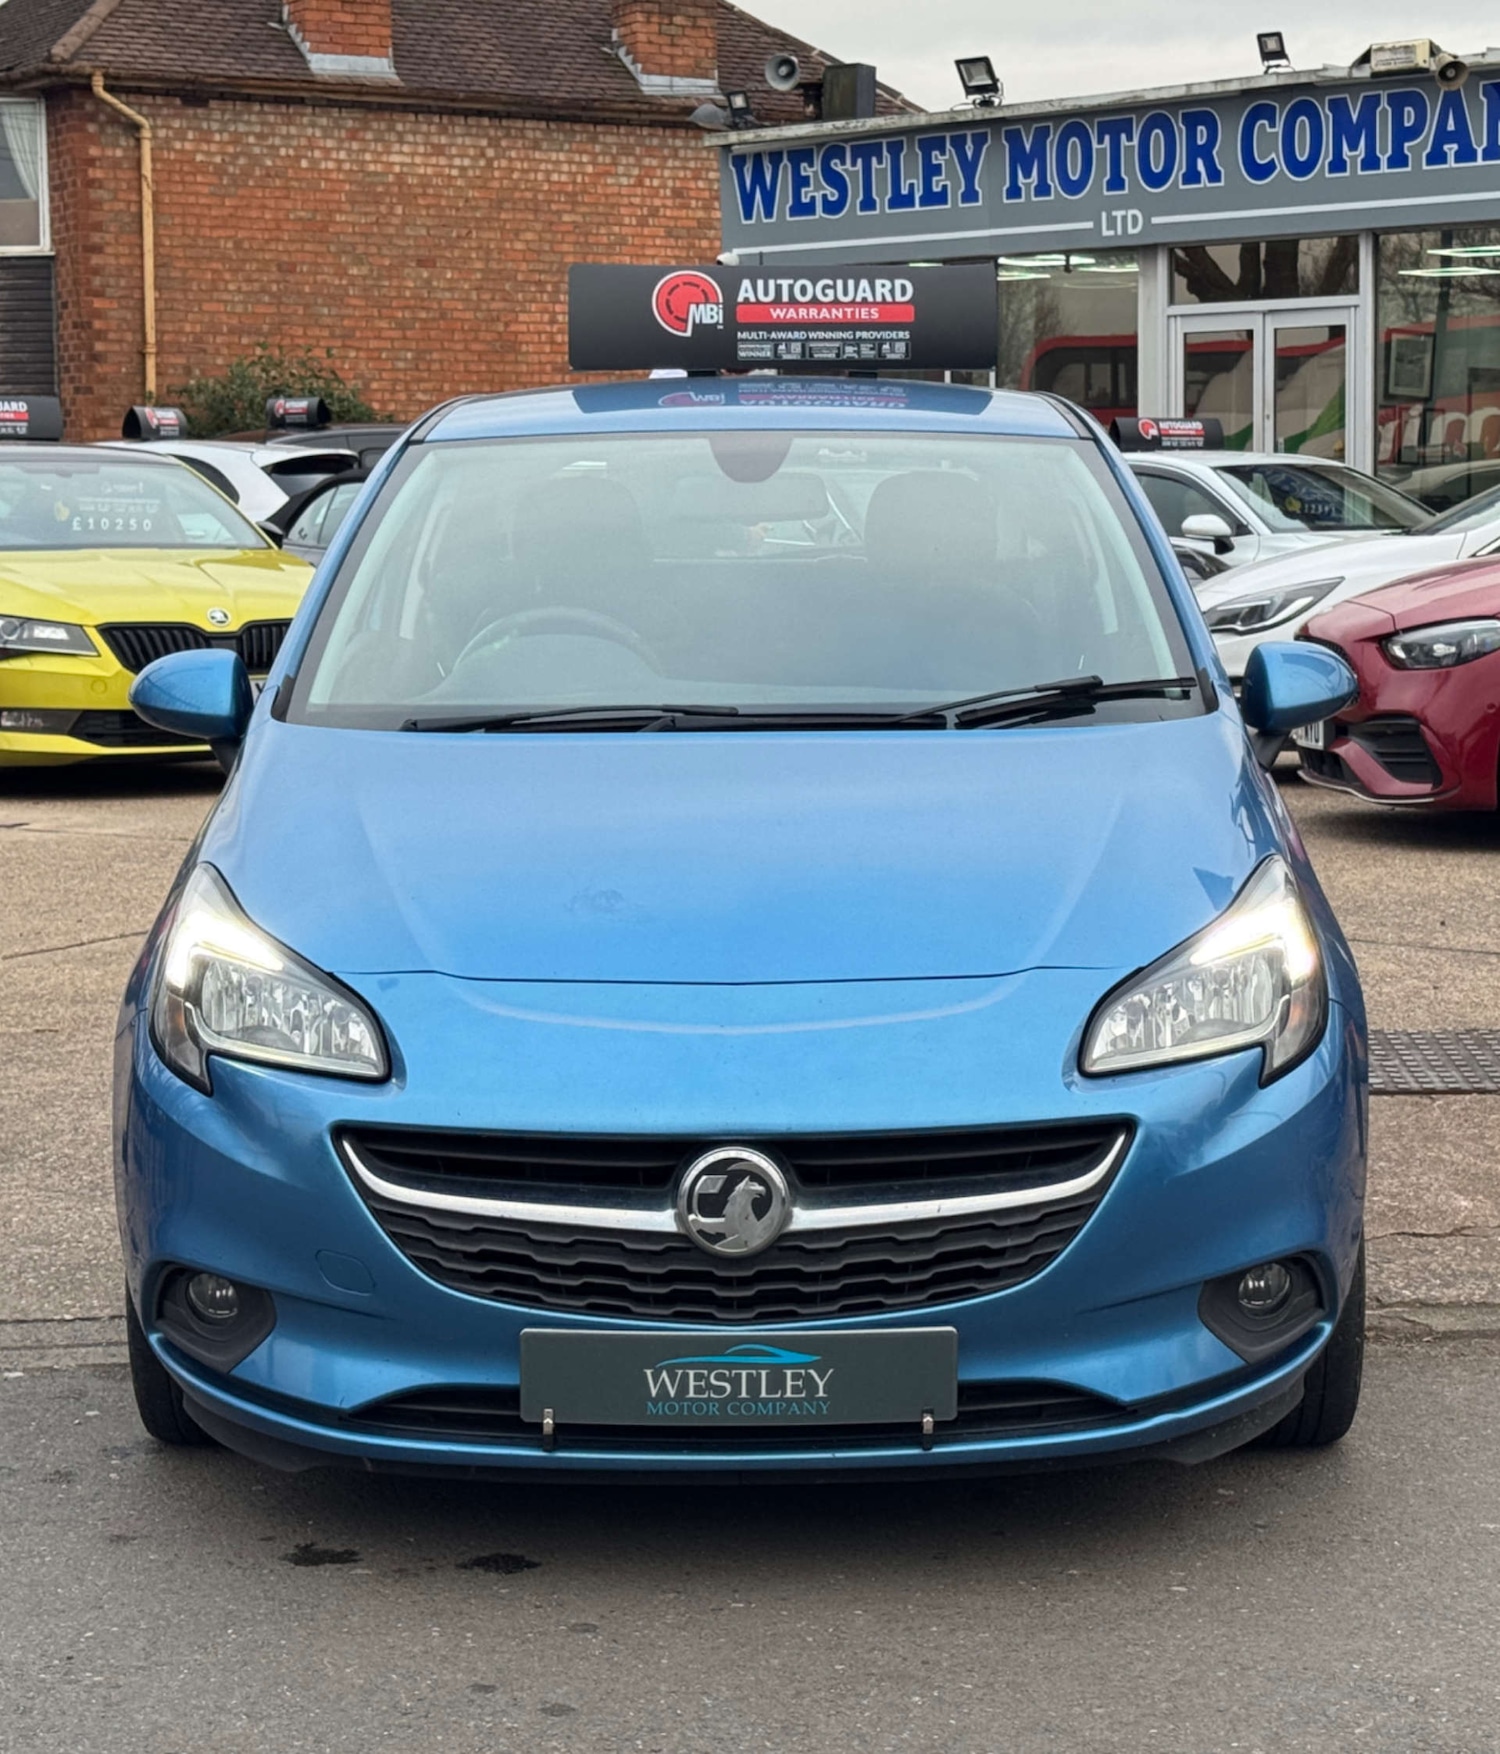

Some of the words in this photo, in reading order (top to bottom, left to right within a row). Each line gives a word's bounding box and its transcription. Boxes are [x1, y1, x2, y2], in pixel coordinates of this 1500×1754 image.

[729, 128, 990, 224] WESTLEY
[1001, 107, 1224, 204] MOTOR
[1101, 208, 1144, 237] LTD
[737, 278, 914, 303] AUTOGUARD
[769, 307, 880, 320] WARRANTIES
[736, 331, 807, 340] MULTI-AWARD
[808, 331, 854, 340] WINNING
[855, 331, 911, 340] PROVIDERS
[643, 1368, 834, 1398] WESTLEY
[646, 1401, 720, 1416] MOTOR
[727, 1401, 830, 1416] COMPANY
